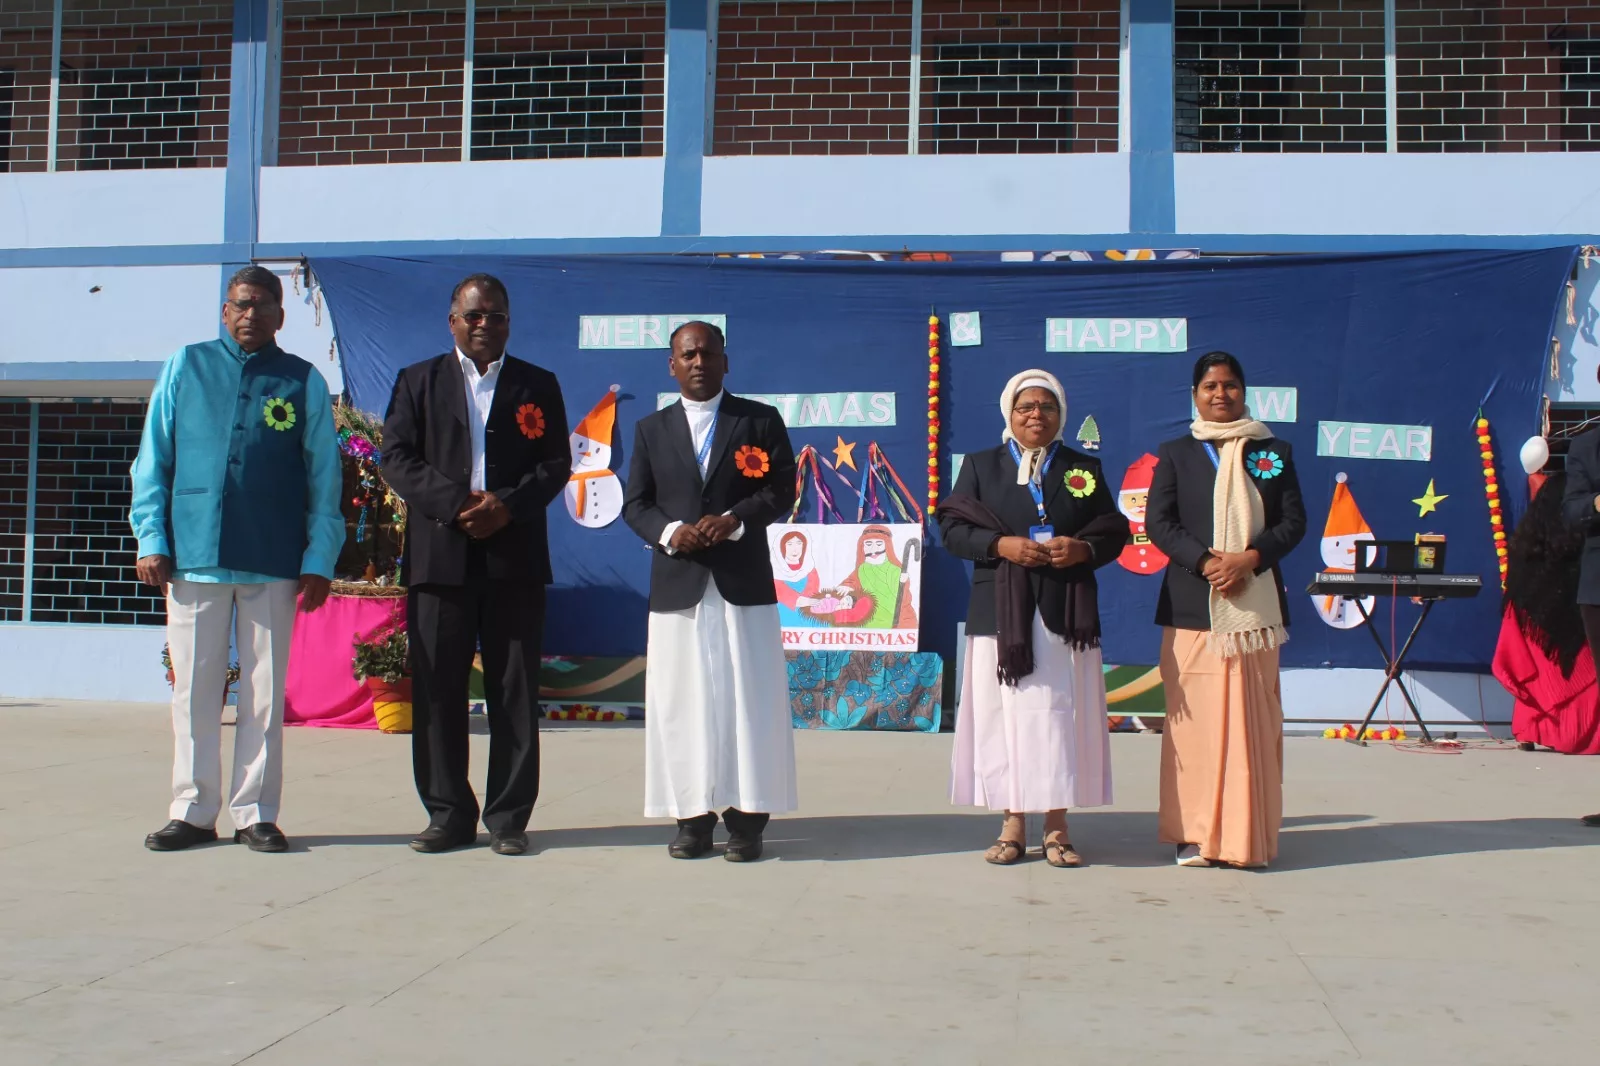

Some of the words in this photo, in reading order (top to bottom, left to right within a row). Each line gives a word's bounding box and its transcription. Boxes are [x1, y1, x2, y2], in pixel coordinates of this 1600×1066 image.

[582, 317, 721, 346] MER
[952, 313, 978, 341] &
[1049, 319, 1187, 349] HAPPY
[1320, 425, 1431, 460] YEAR
[1328, 574, 1355, 582] YAMAHA
[808, 632, 916, 646] CHRISTMAS
